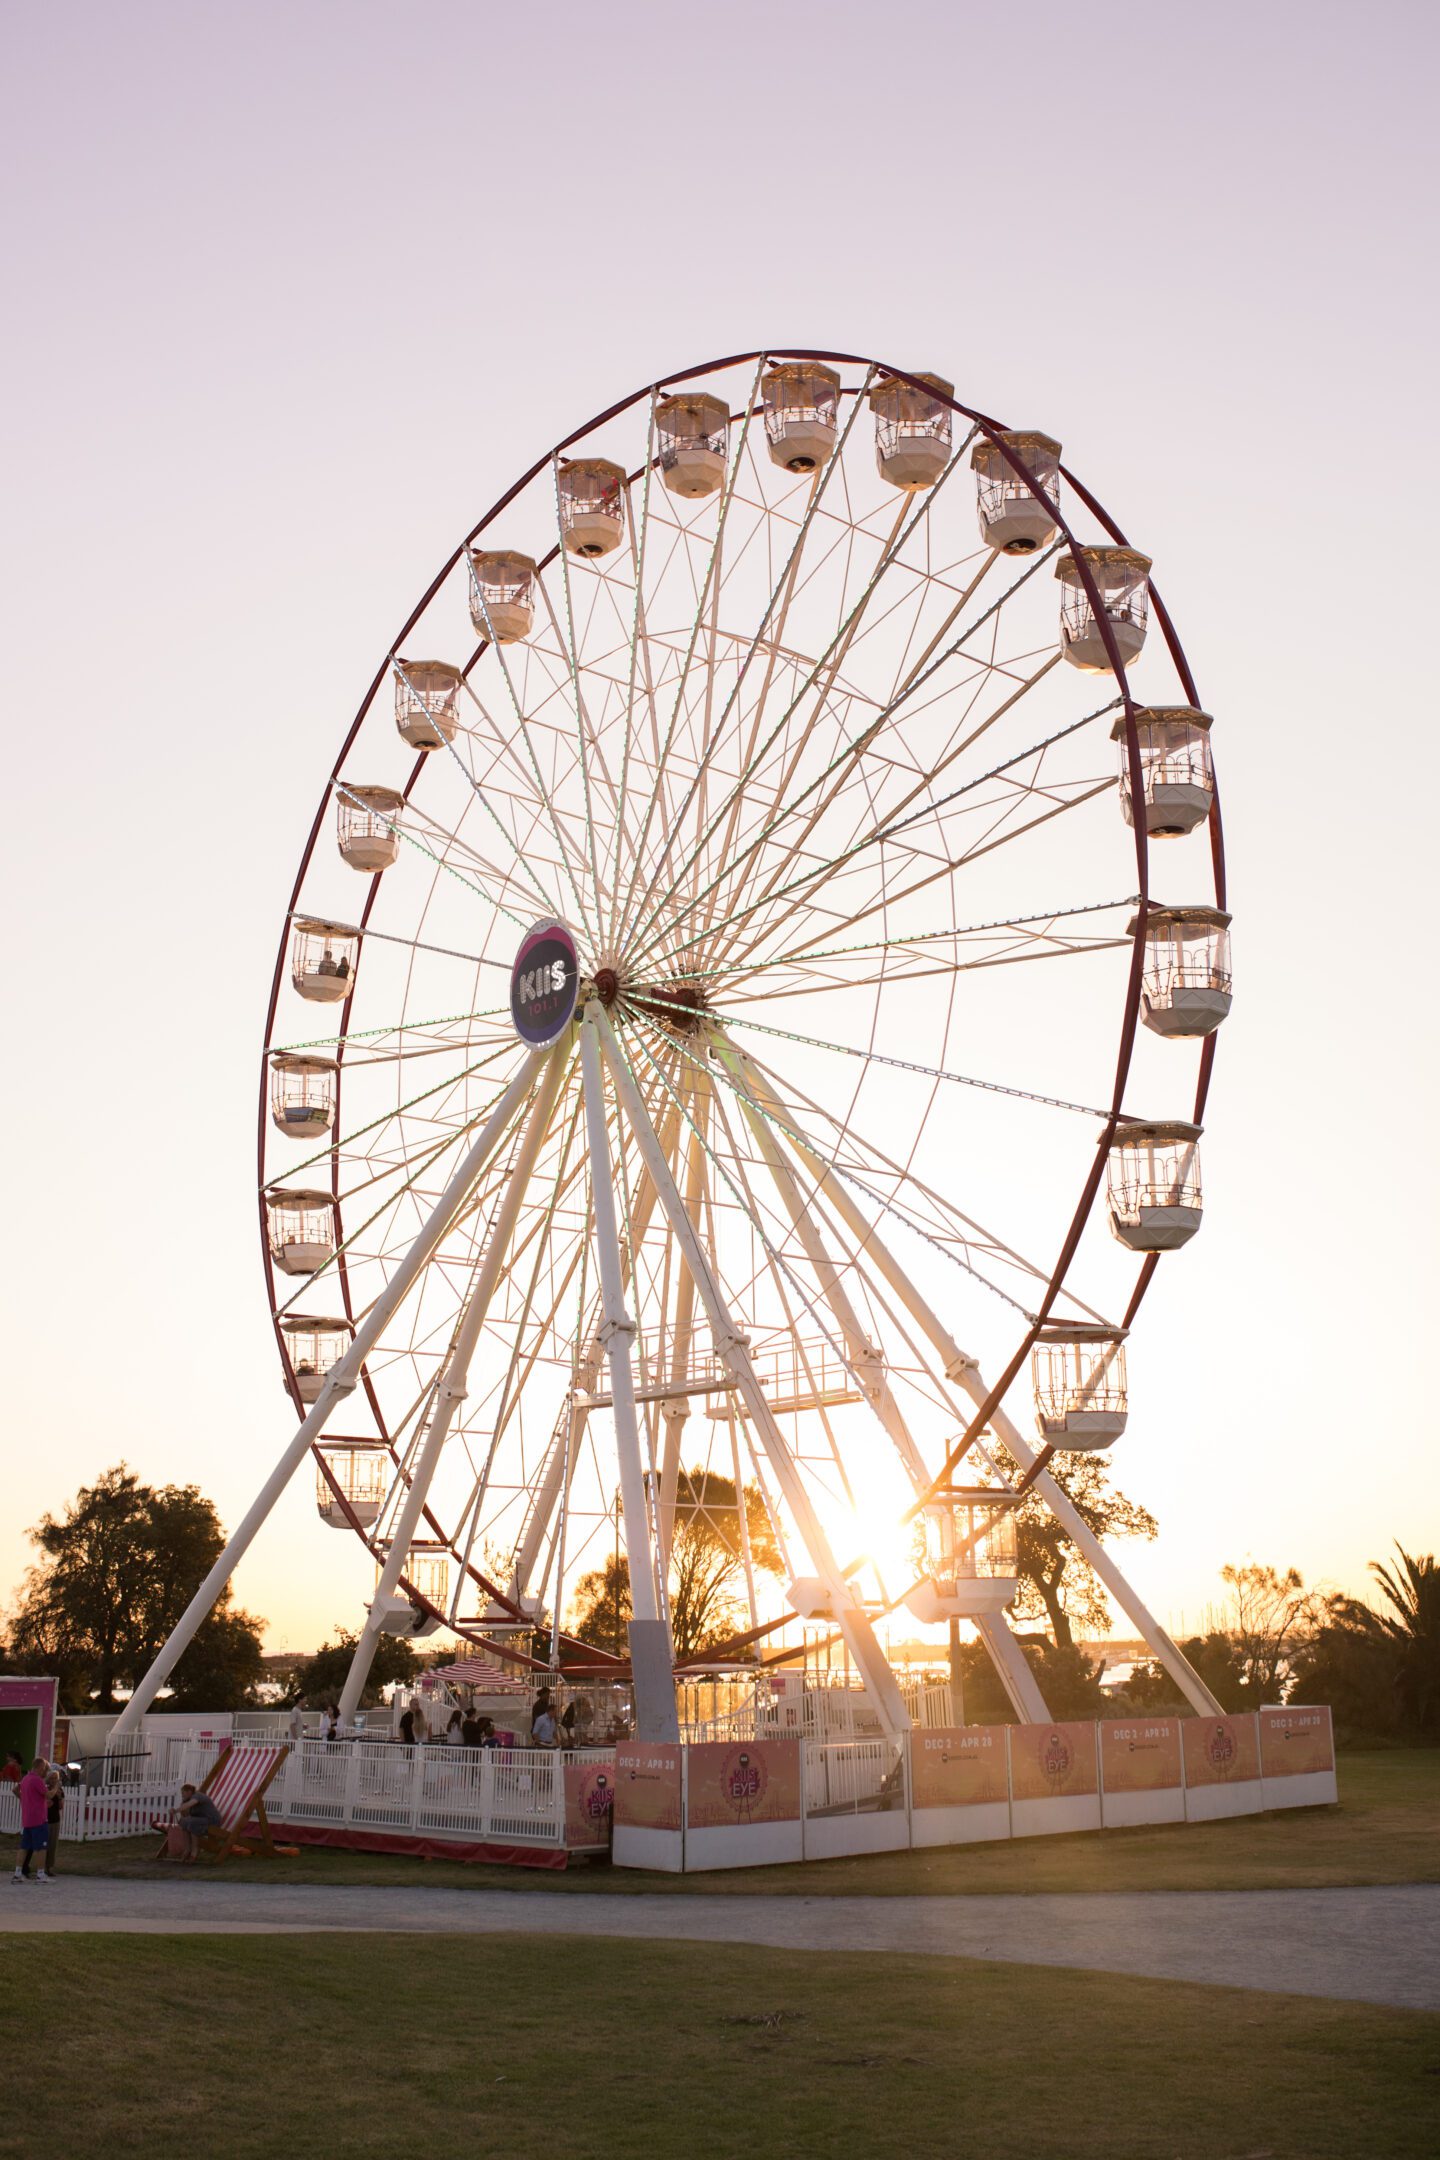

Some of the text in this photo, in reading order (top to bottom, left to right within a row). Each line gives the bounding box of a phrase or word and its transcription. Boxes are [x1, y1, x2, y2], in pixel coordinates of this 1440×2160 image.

[520, 960, 566, 1004] KIIS
[1113, 1729, 1130, 1740] DEC
[924, 1739, 943, 1750] DEC
[960, 1737, 979, 1748] APR
[619, 1757, 634, 1768] DEC
[647, 1759, 663, 1769] APR
[733, 1782, 756, 1797] EYE
[591, 1802, 610, 1817] EY
